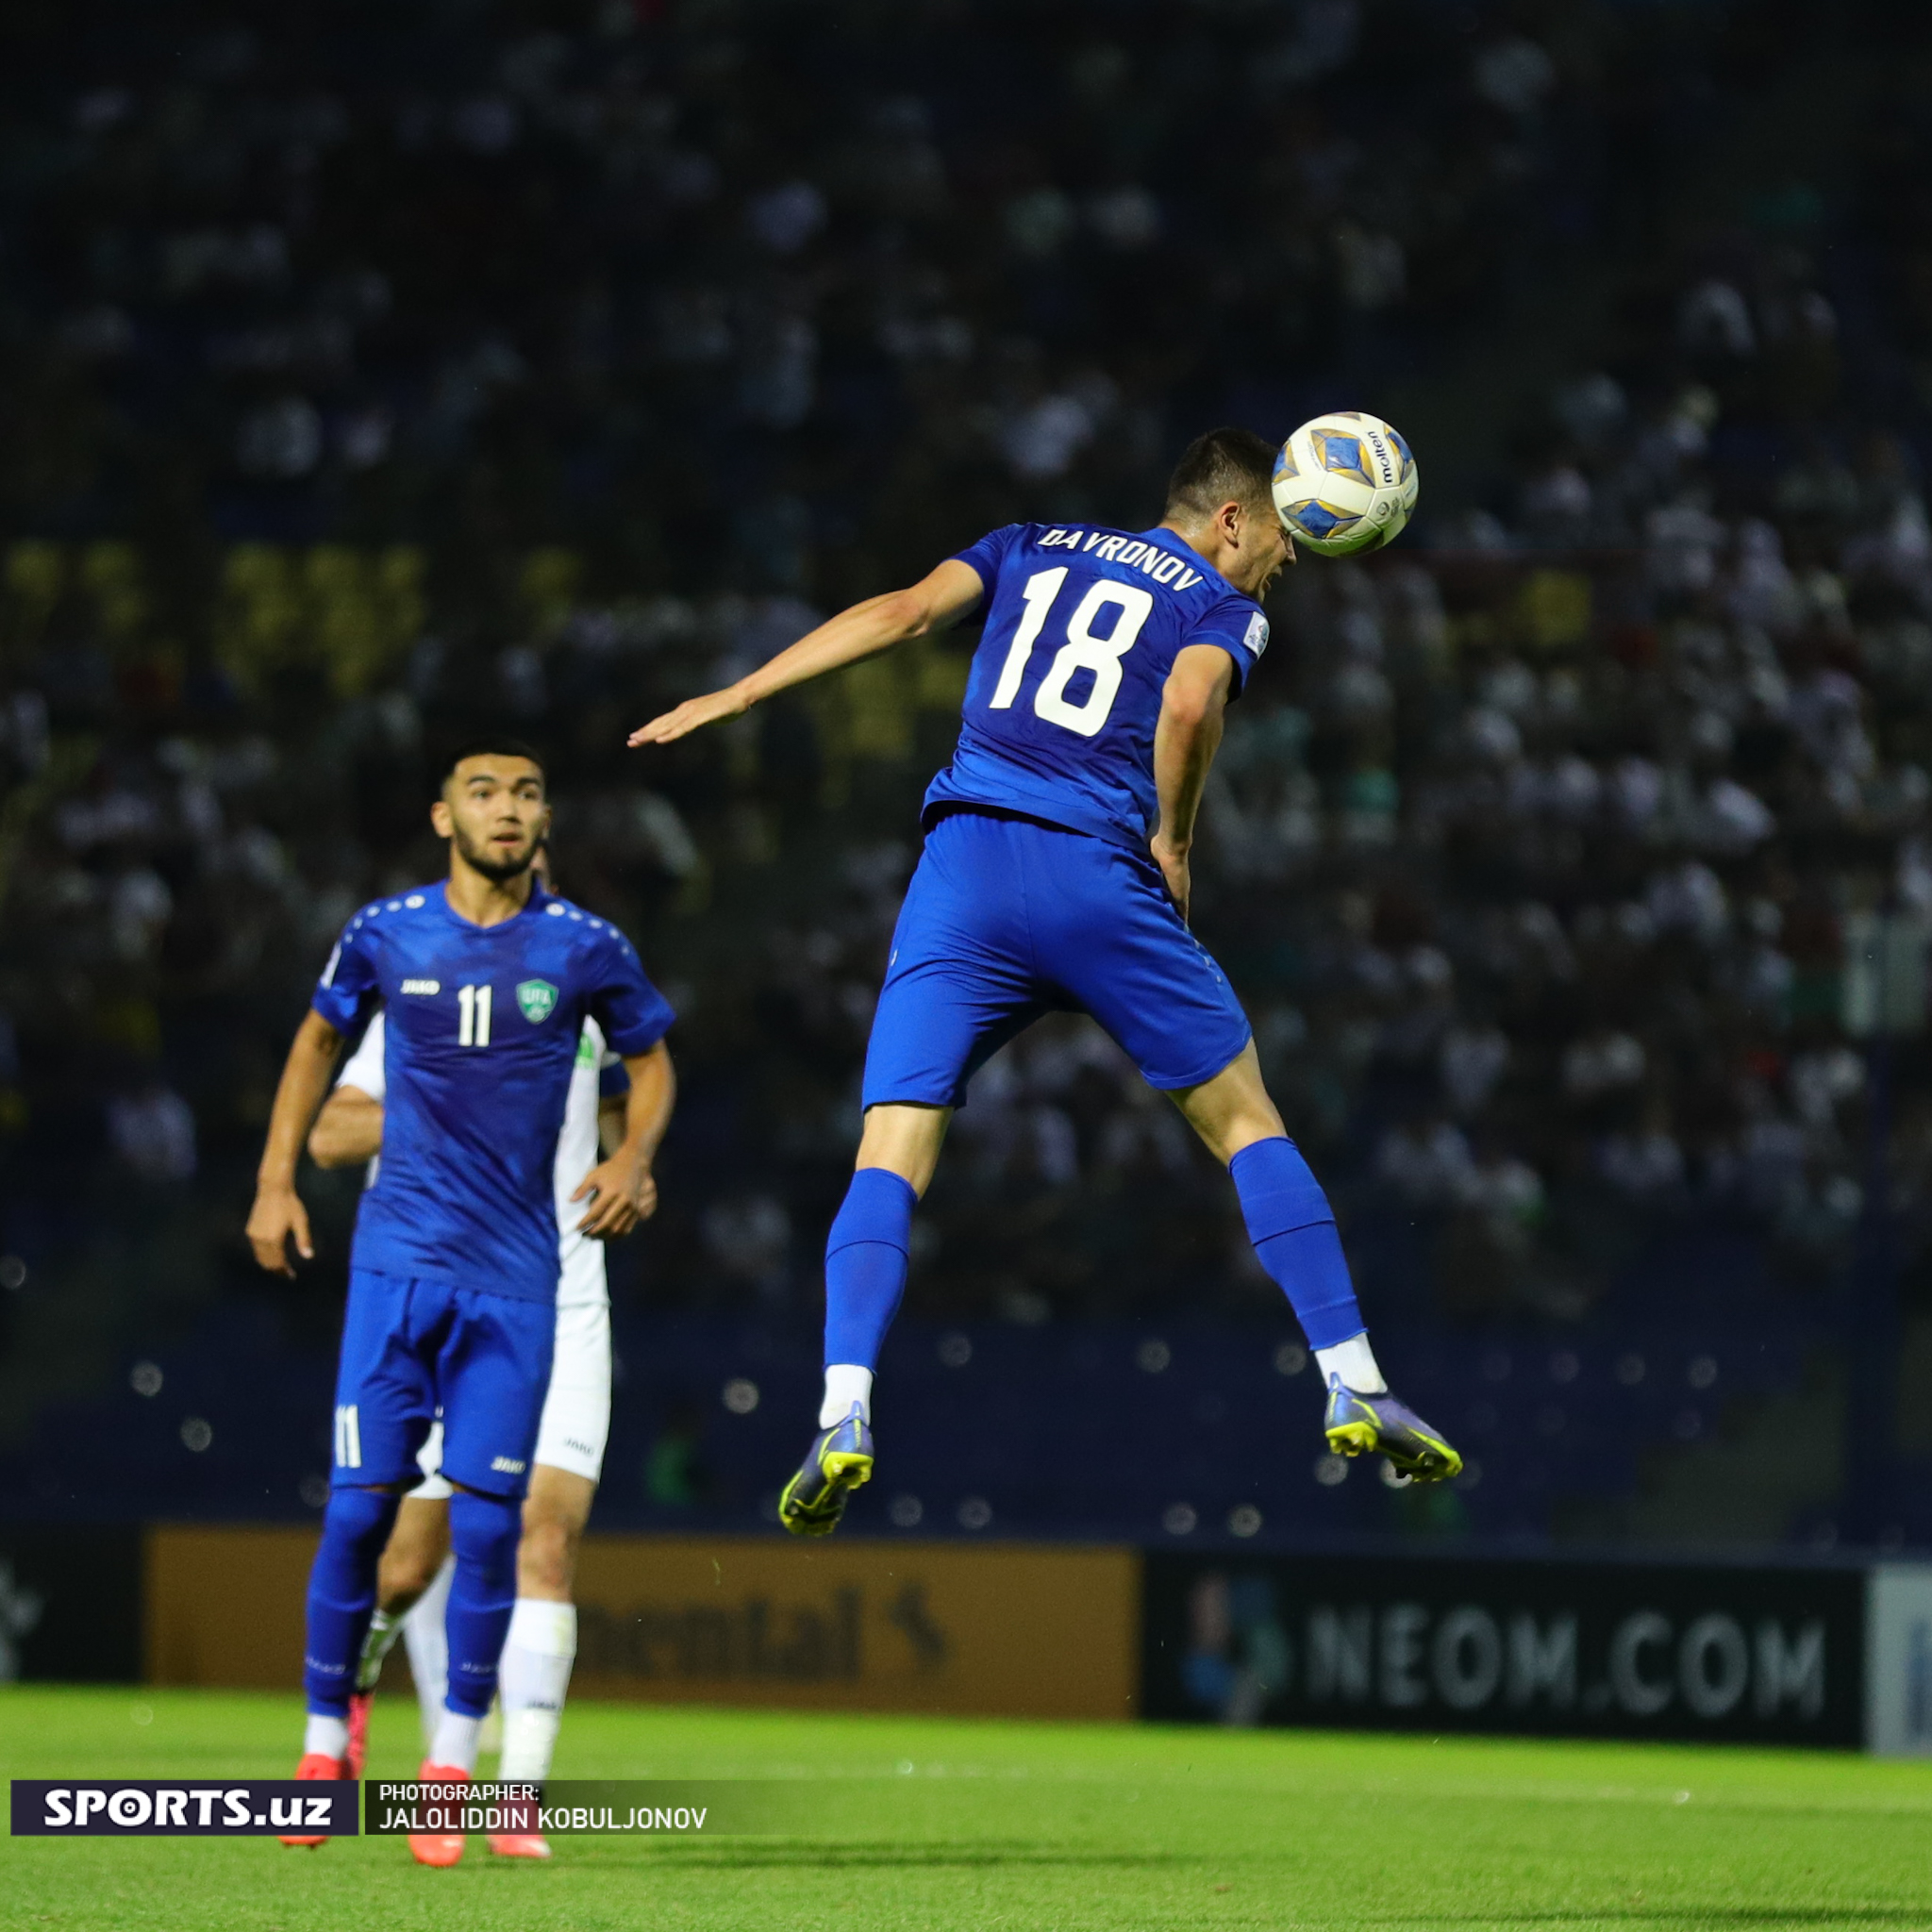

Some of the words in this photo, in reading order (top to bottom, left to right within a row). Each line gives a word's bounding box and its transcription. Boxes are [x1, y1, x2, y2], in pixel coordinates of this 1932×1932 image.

[1367, 430, 1393, 484] molten
[1038, 529, 1204, 591] DAVRONOV
[989, 566, 1153, 737] 18
[458, 984, 491, 1046] 11
[334, 1404, 361, 1468] 11
[1306, 1606, 1826, 1719] NEOM.COM
